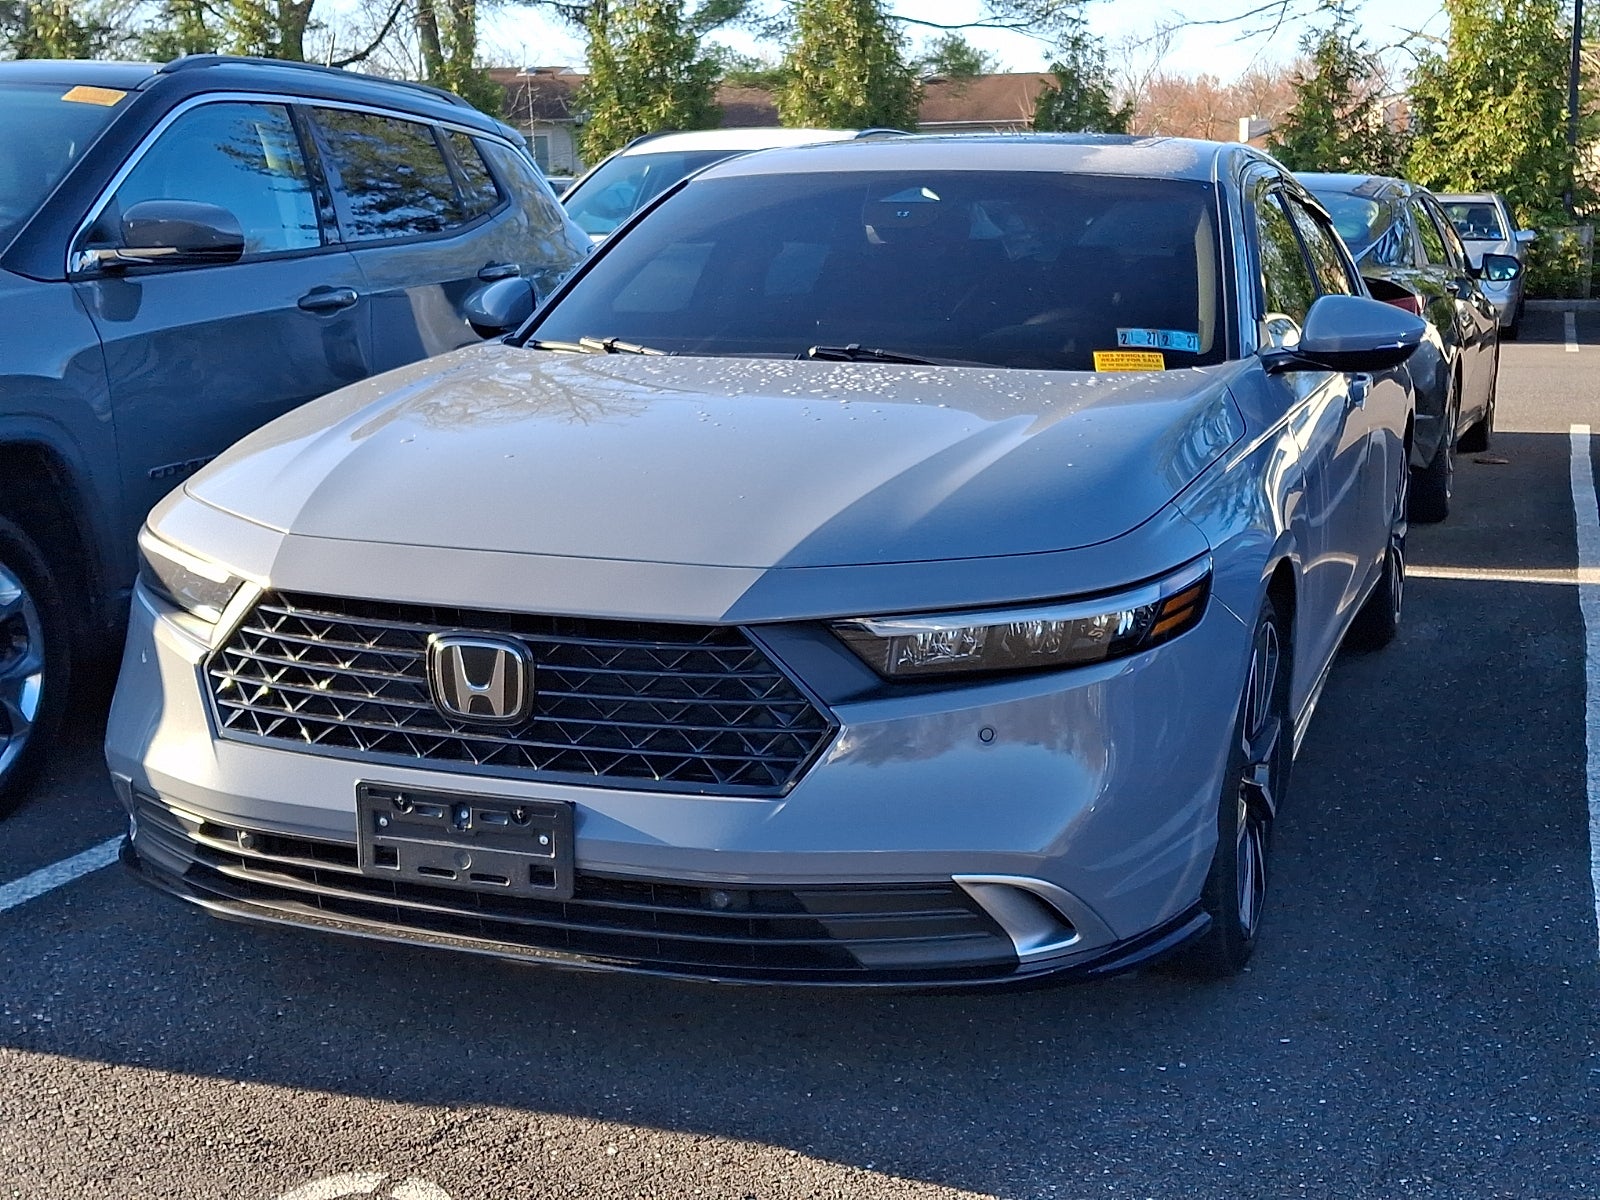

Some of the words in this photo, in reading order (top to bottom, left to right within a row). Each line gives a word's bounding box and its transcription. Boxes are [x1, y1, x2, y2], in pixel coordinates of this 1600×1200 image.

[1121, 333, 1128, 344] 2
[1146, 332, 1156, 345] 27
[1162, 334, 1170, 346] 2
[1187, 335, 1197, 349] 27
[452, 645, 506, 717] H
